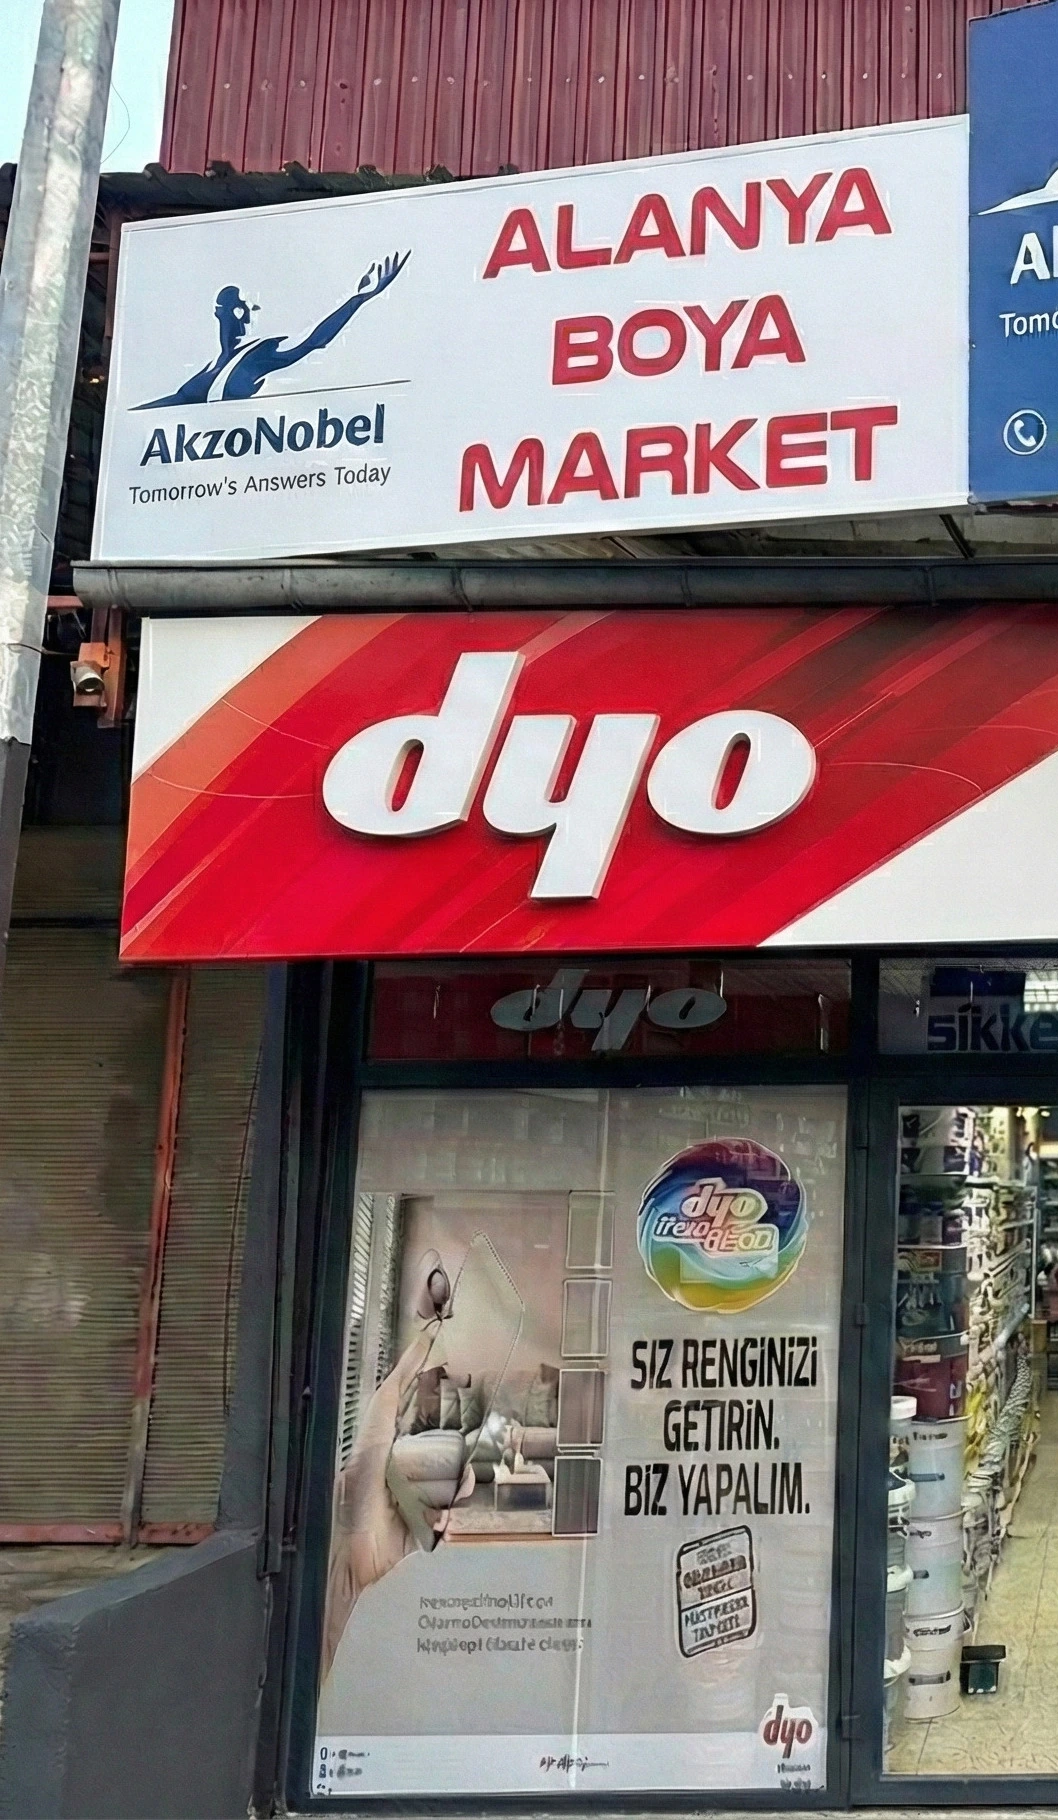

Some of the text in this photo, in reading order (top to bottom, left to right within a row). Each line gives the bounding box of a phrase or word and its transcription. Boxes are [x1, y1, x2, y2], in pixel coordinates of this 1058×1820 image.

[482, 167, 893, 280] ALANYA
[552, 294, 805, 386] BOYA
[139, 403, 386, 467] AkzoNobel
[459, 404, 899, 513] MARKET
[129, 463, 391, 505] Tomorrow's Answers Today
[322, 650, 816, 902] dyo
[491, 968, 727, 1051] dyo
[681, 1184, 758, 1228] dyo
[678, 1462, 810, 1516] YAPALIM.
[763, 1704, 812, 1759] dyo
